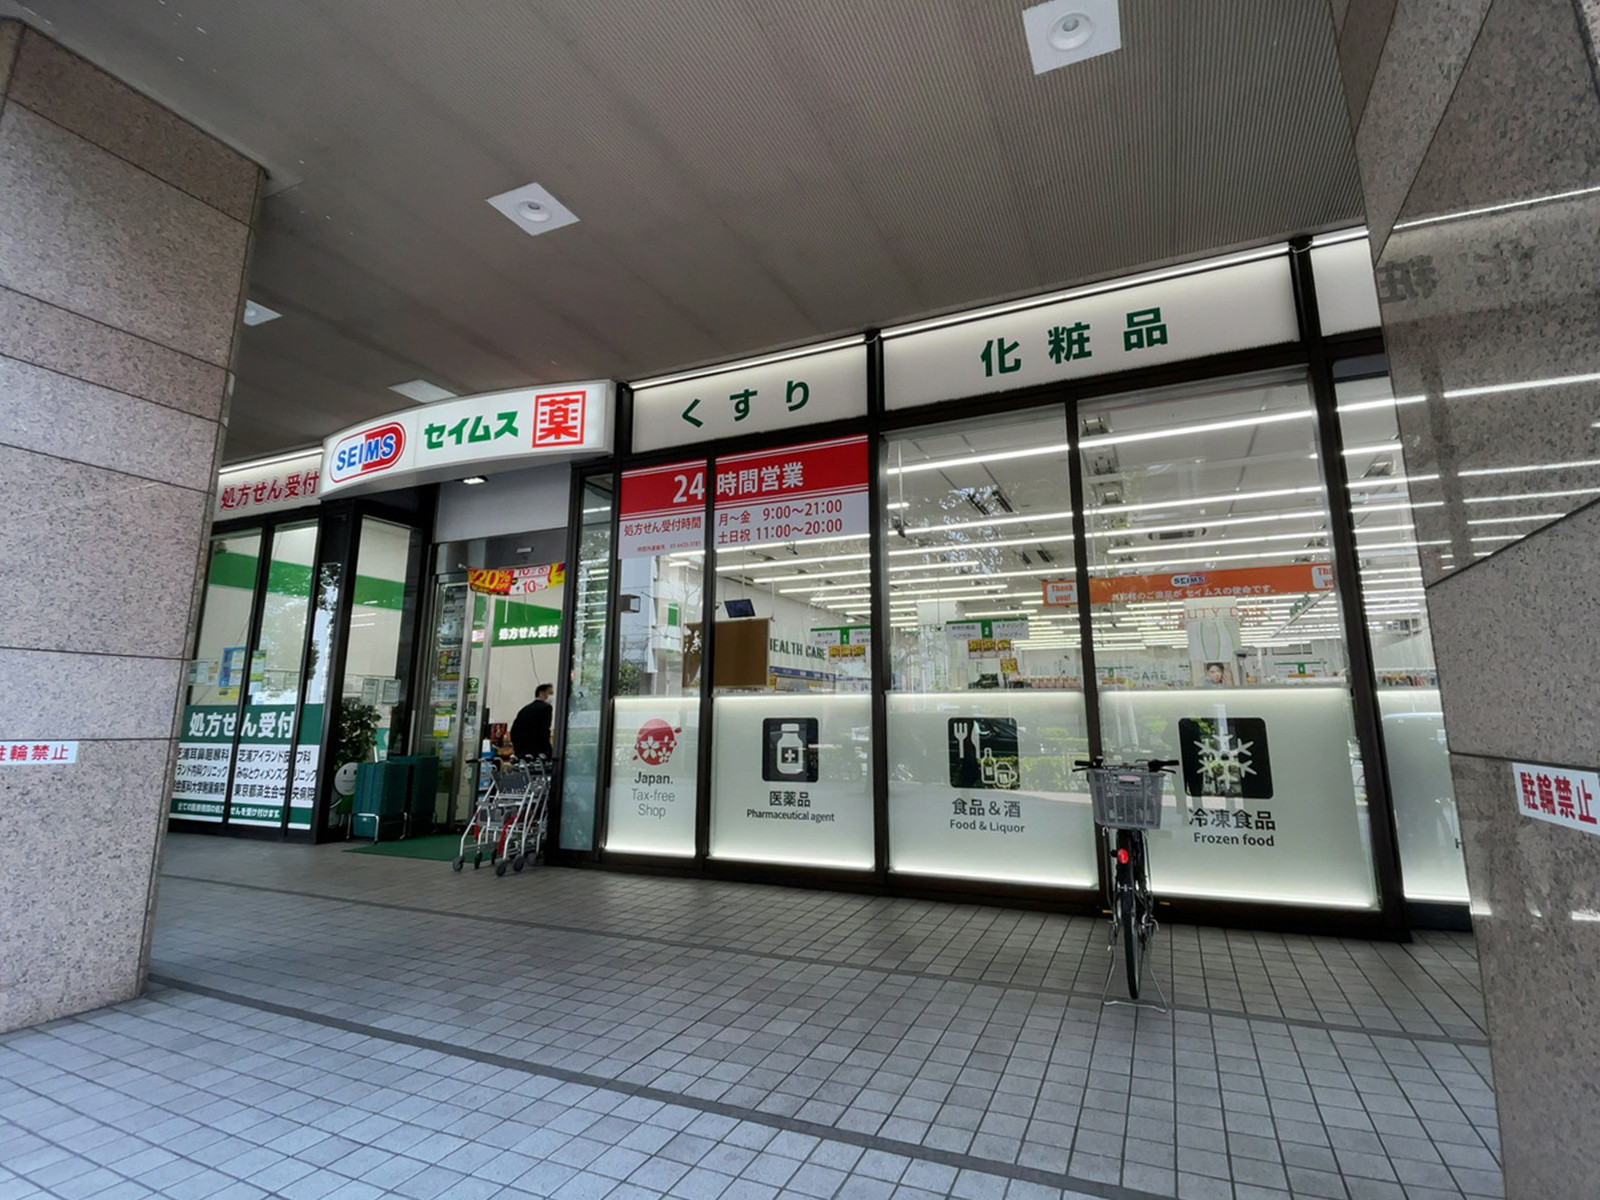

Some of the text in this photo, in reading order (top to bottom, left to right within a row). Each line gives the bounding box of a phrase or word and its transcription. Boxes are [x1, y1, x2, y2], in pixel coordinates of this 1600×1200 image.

[980, 307, 1168, 378] 化粧品
[681, 380, 810, 429] くすり
[424, 410, 520, 450] セイムス
[534, 393, 585, 446] 薬
[335, 433, 396, 472] SEIMS
[220, 472, 320, 509] 処方せん受付
[623, 516, 702, 537] 処方せん受付時間
[717, 529, 751, 545] 土日祝
[499, 624, 559, 641] 処方せん受付
[189, 712, 296, 738] 処方せん受付
[634, 772, 674, 785] Japan.
[632, 788, 676, 803] Tax-free
[769, 790, 811, 807] 医薬品
[1519, 771, 1598, 825] 駐輪禁止
[638, 804, 667, 820] Shop
[746, 809, 836, 824] Pharmaceutical agent
[1188, 808, 1276, 831] 冷凍食品
[950, 819, 1025, 834] Food & Liquor
[1194, 832, 1275, 847] Frozen food
